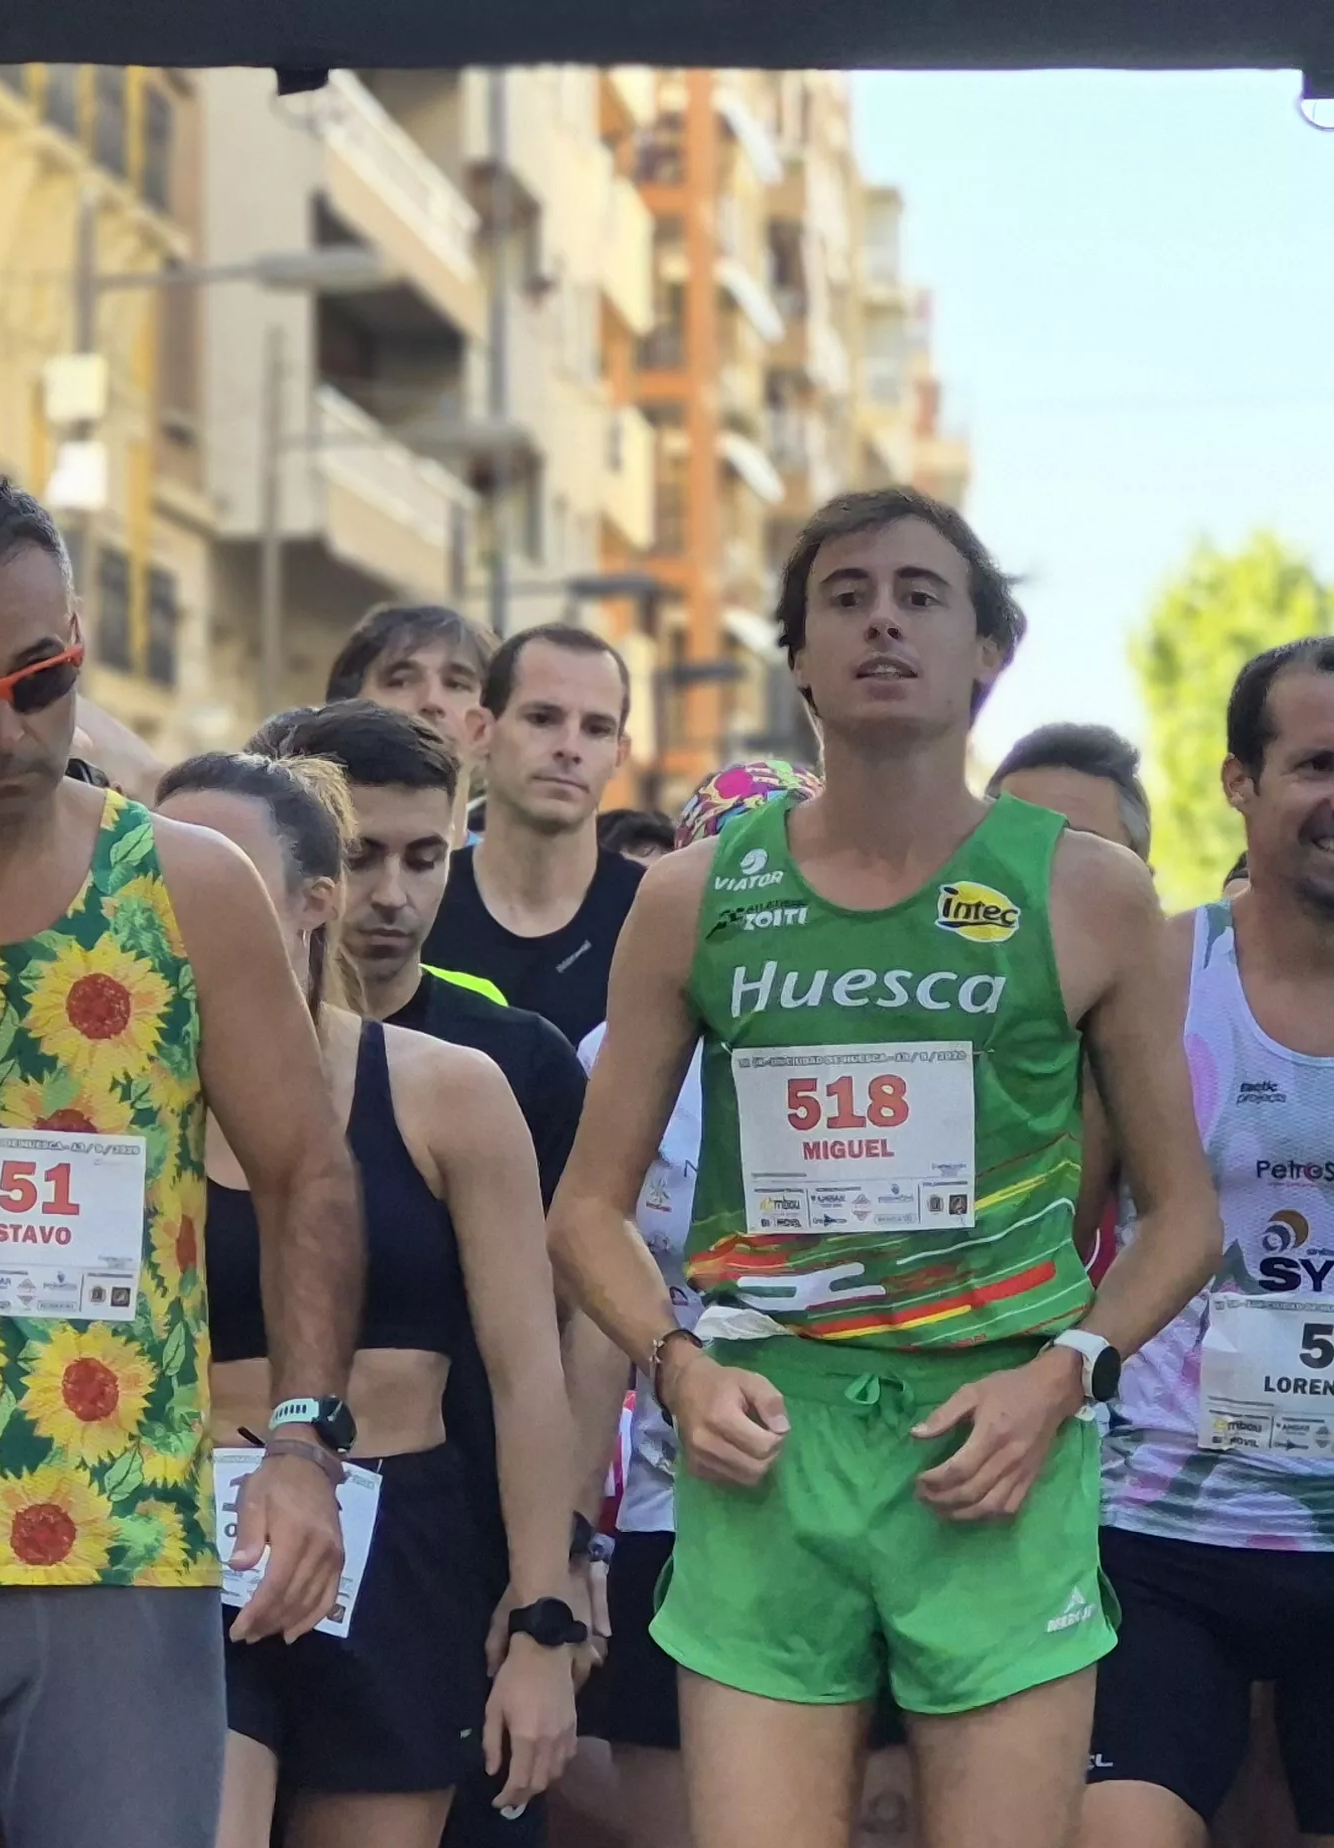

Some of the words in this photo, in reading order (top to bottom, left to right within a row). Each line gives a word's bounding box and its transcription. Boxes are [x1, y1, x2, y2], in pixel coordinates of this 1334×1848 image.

[714, 870, 784, 891] VIATOR
[731, 961, 1007, 1018] Huesca
[787, 1074, 910, 1131] 518
[803, 1138, 895, 1160] MIGUEL
